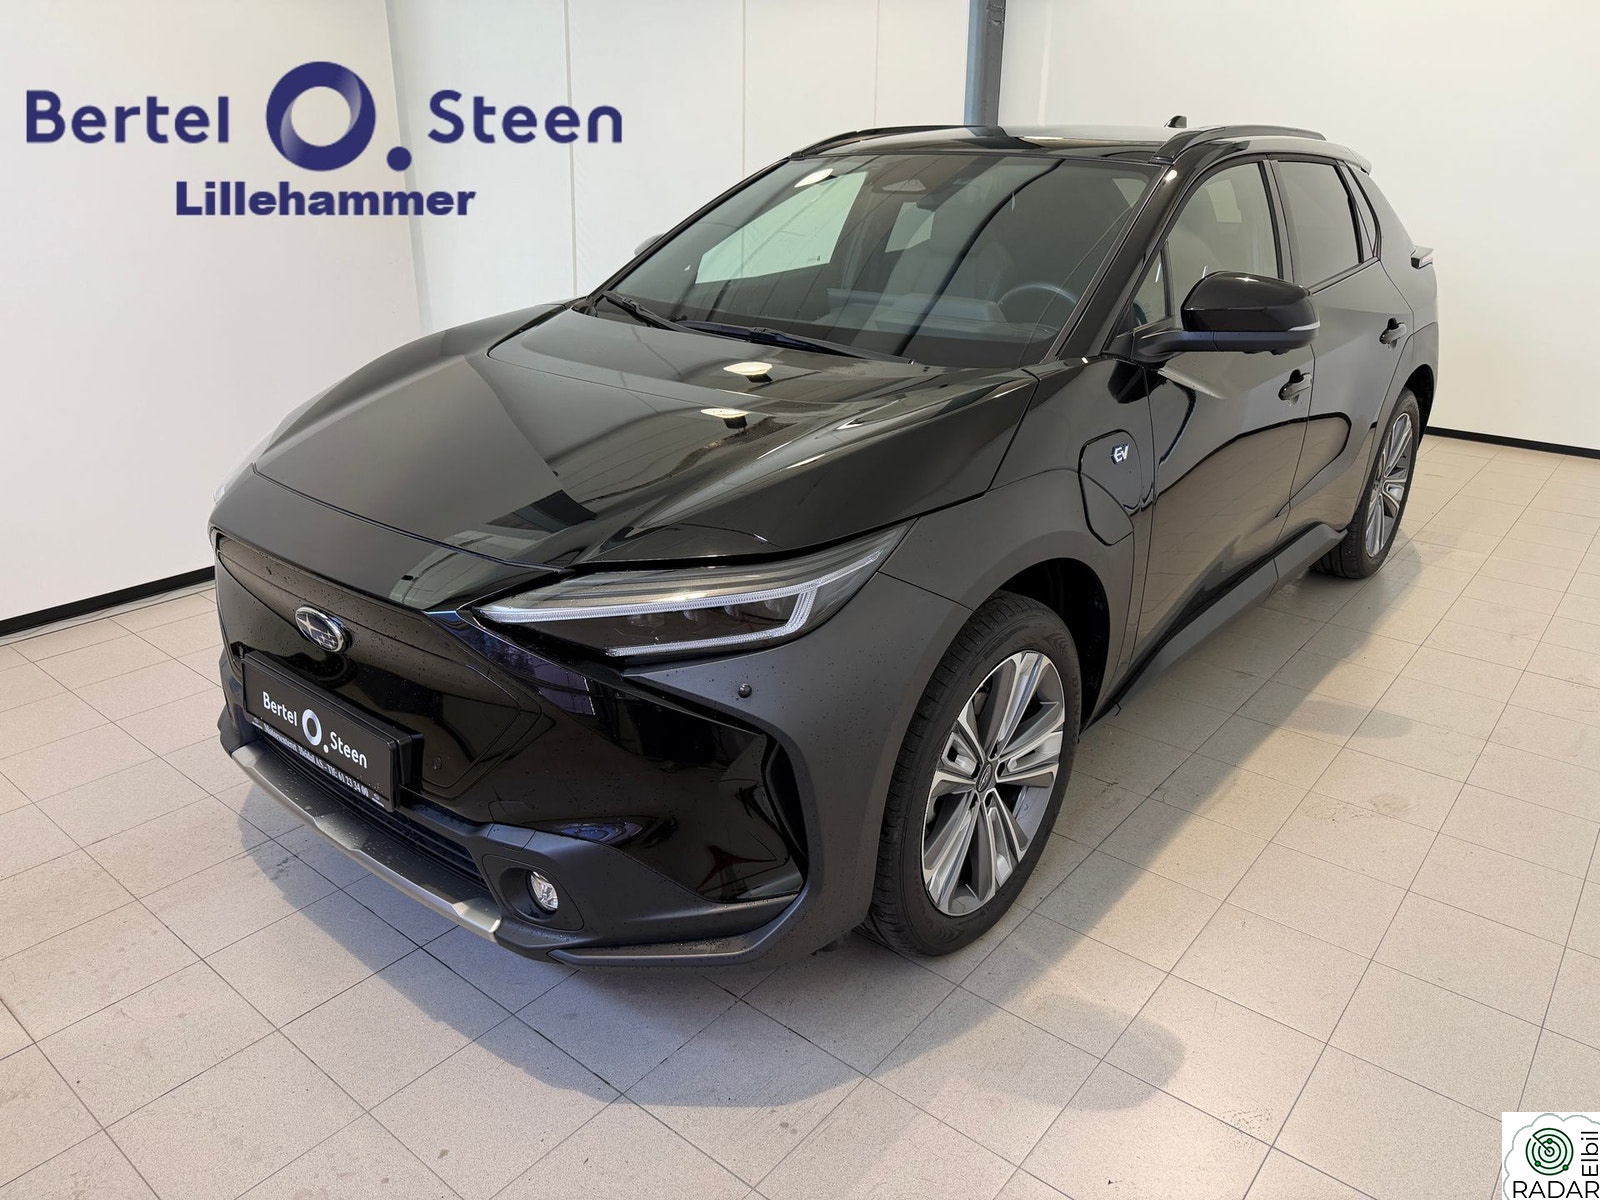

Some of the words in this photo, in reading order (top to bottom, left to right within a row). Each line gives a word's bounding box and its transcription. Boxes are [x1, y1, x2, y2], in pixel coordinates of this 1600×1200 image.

[1112, 445, 1129, 463] EV
[262, 691, 298, 727] Bertel
[330, 731, 368, 769] Steen
